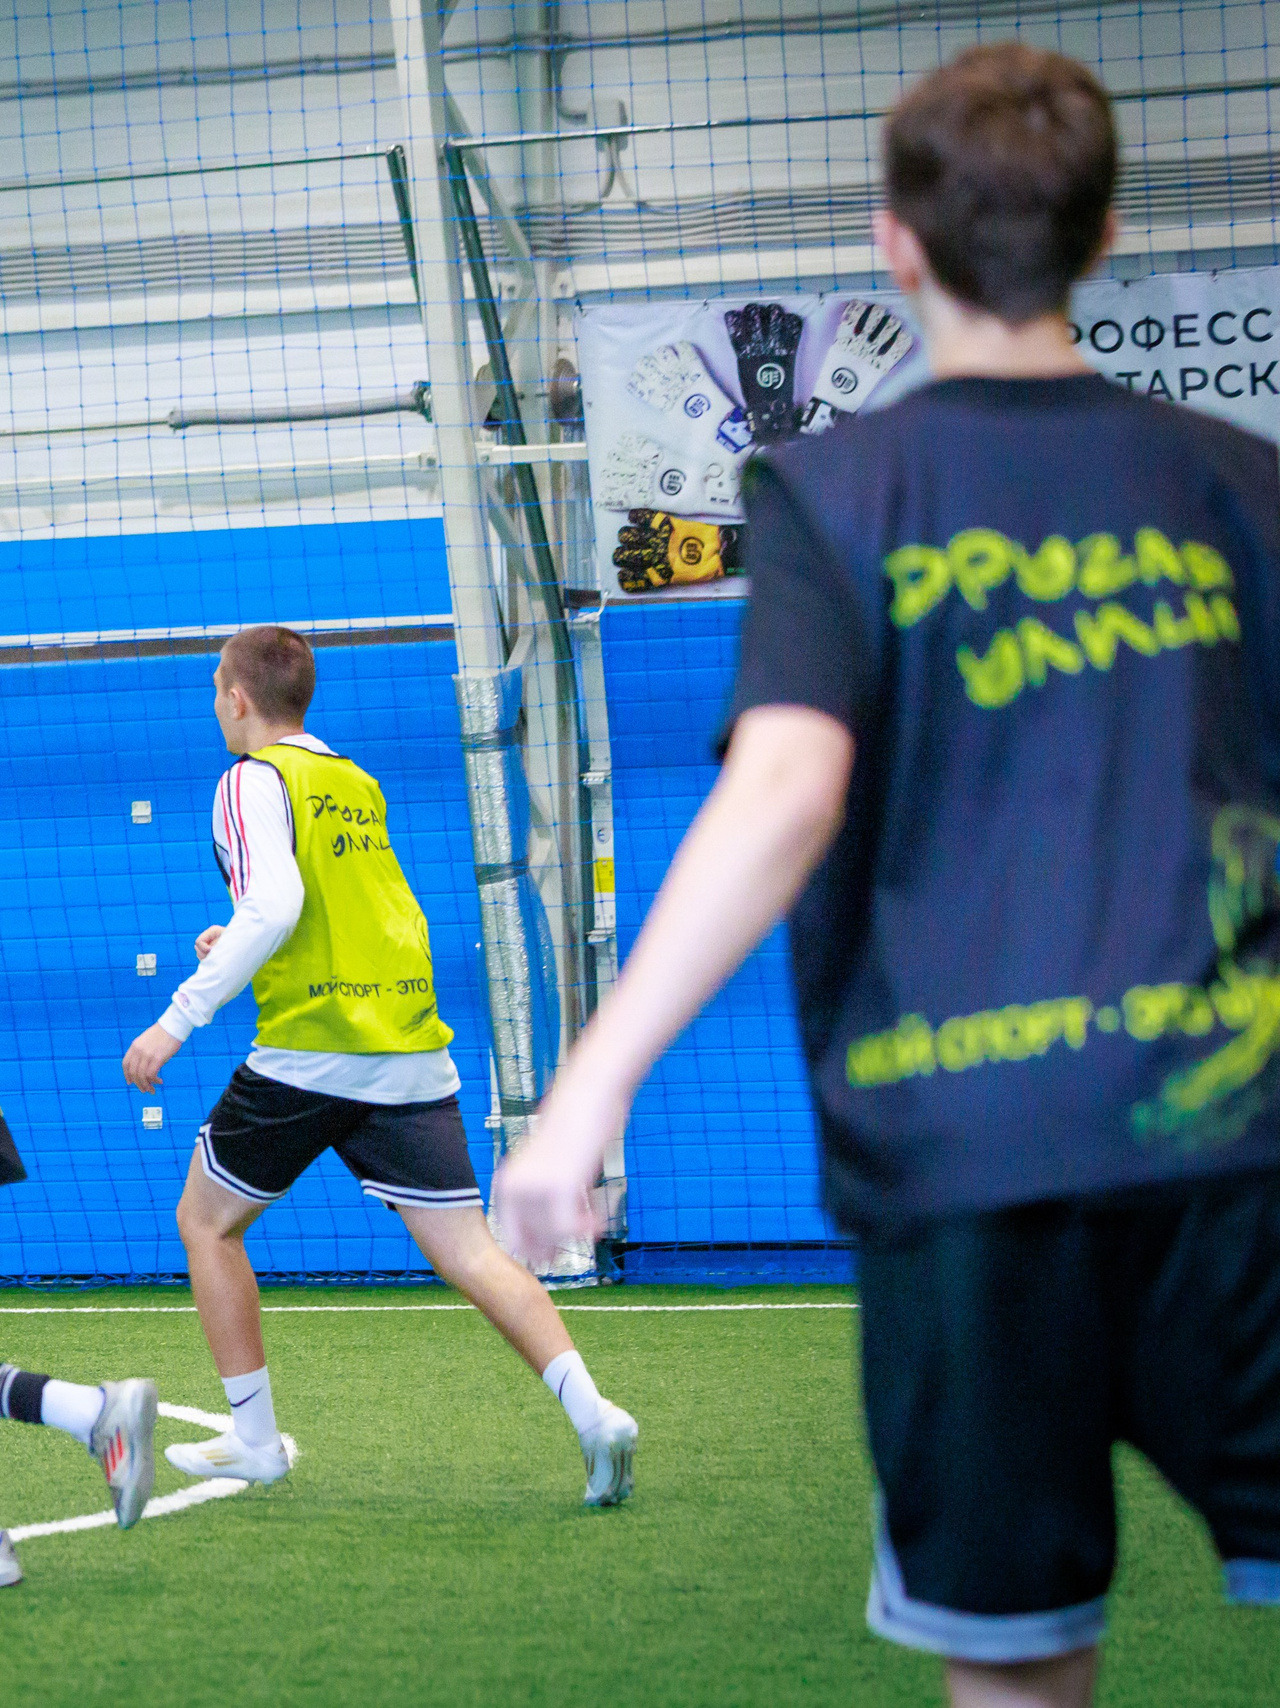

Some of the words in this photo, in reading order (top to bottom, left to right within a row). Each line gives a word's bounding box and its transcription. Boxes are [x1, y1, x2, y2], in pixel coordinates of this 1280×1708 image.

[308, 976, 338, 998] МОЙ
[339, 981, 382, 998] СПОРТ
[396, 978, 429, 995] ЭТО
[937, 996, 1092, 1074] СПОРТ
